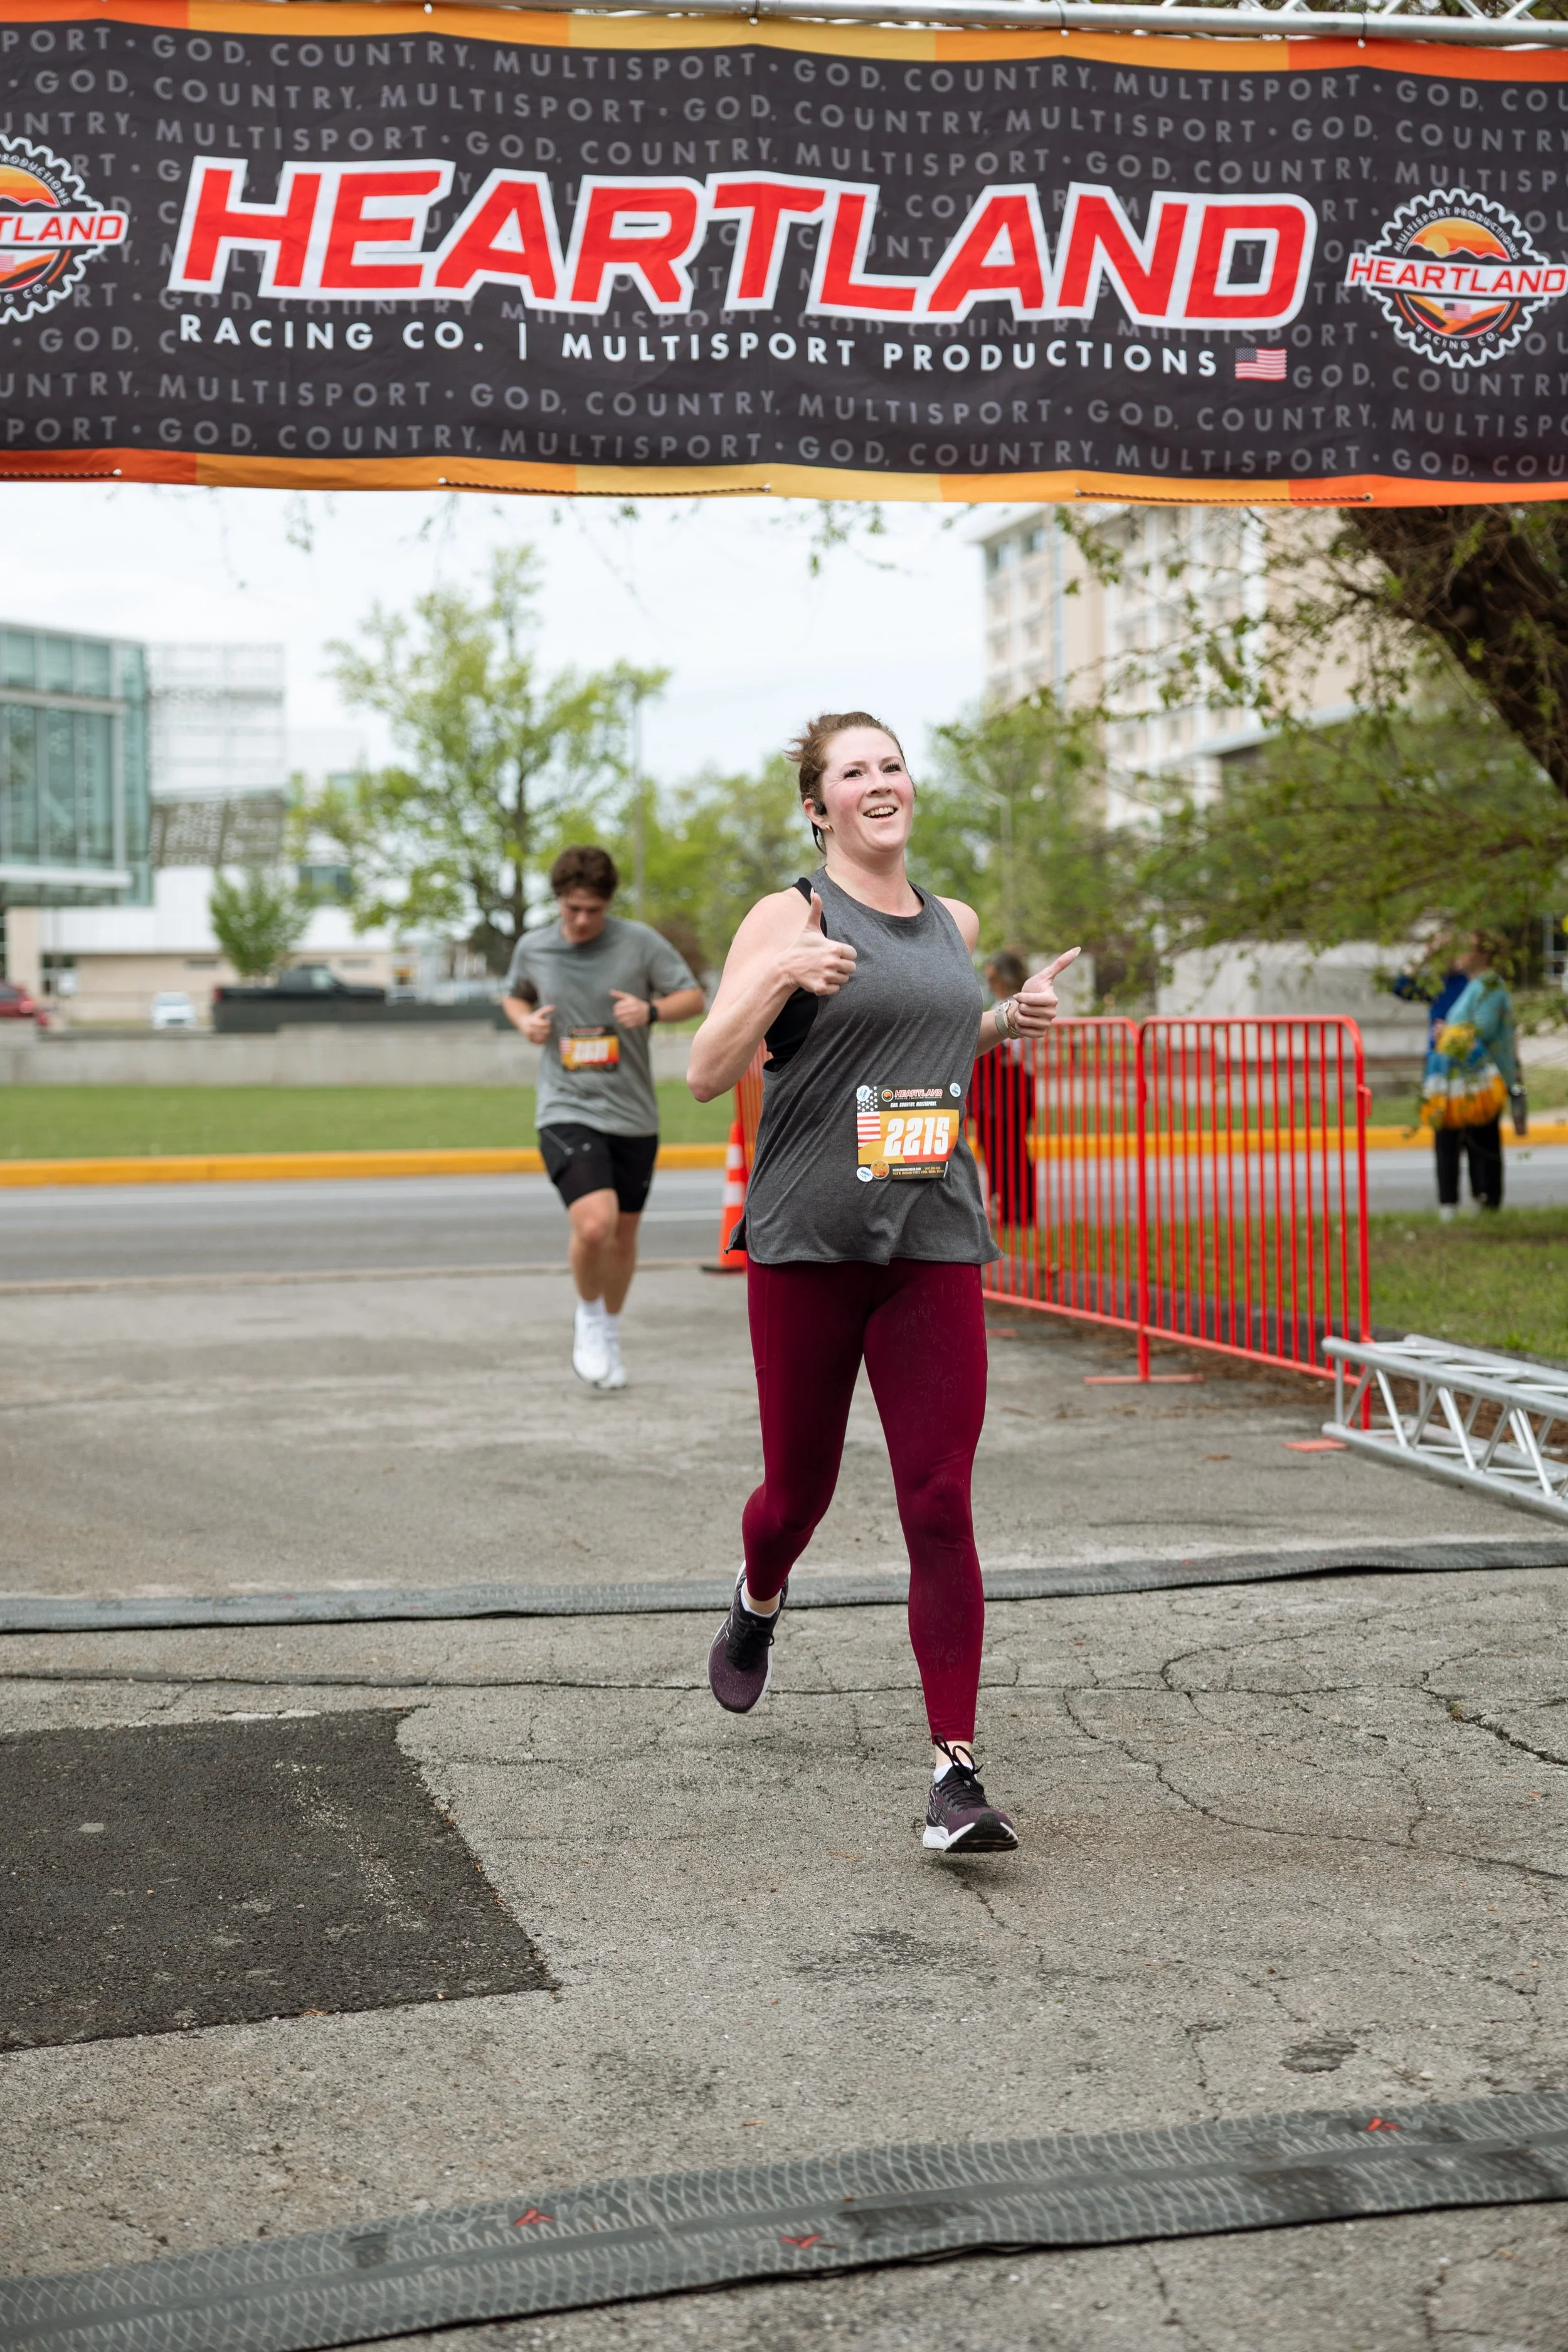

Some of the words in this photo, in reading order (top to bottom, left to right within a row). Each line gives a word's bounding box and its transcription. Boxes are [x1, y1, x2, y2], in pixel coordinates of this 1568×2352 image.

[1, 27, 112, 53] PORT
[493, 50, 756, 82] MULTISPORT
[1113, 72, 1360, 102] MULTISPORT
[379, 83, 645, 123] MULTISPORT
[1005, 106, 1255, 143] MULTISPORT
[156, 119, 427, 152] MULTISPORT
[795, 142, 1050, 177] MULTISPORT
[1394, 161, 1568, 193] MULTISP
[167, 155, 1318, 330] HEARTLAND
[1394, 206, 1451, 253] MULTISPORT
[1454, 206, 1522, 260] PRODUCTIONS
[1348, 256, 1567, 295] HEARTLAND
[179, 314, 374, 351] RACING
[402, 320, 484, 352] CO.
[561, 332, 856, 367] MULTISPORT
[883, 339, 1217, 377] PRODUCTIONS
[1415, 322, 1471, 351] RACING
[159, 373, 432, 408] MULTISPORT
[798, 393, 1052, 425] MULTISPORT
[6, 416, 118, 443] PORT
[501, 429, 761, 460] MULTISPORT
[1116, 443, 1360, 474] MULTISPORT
[894, 1088, 943, 1098] HEARTLAND
[883, 1117, 950, 1157] 2215
